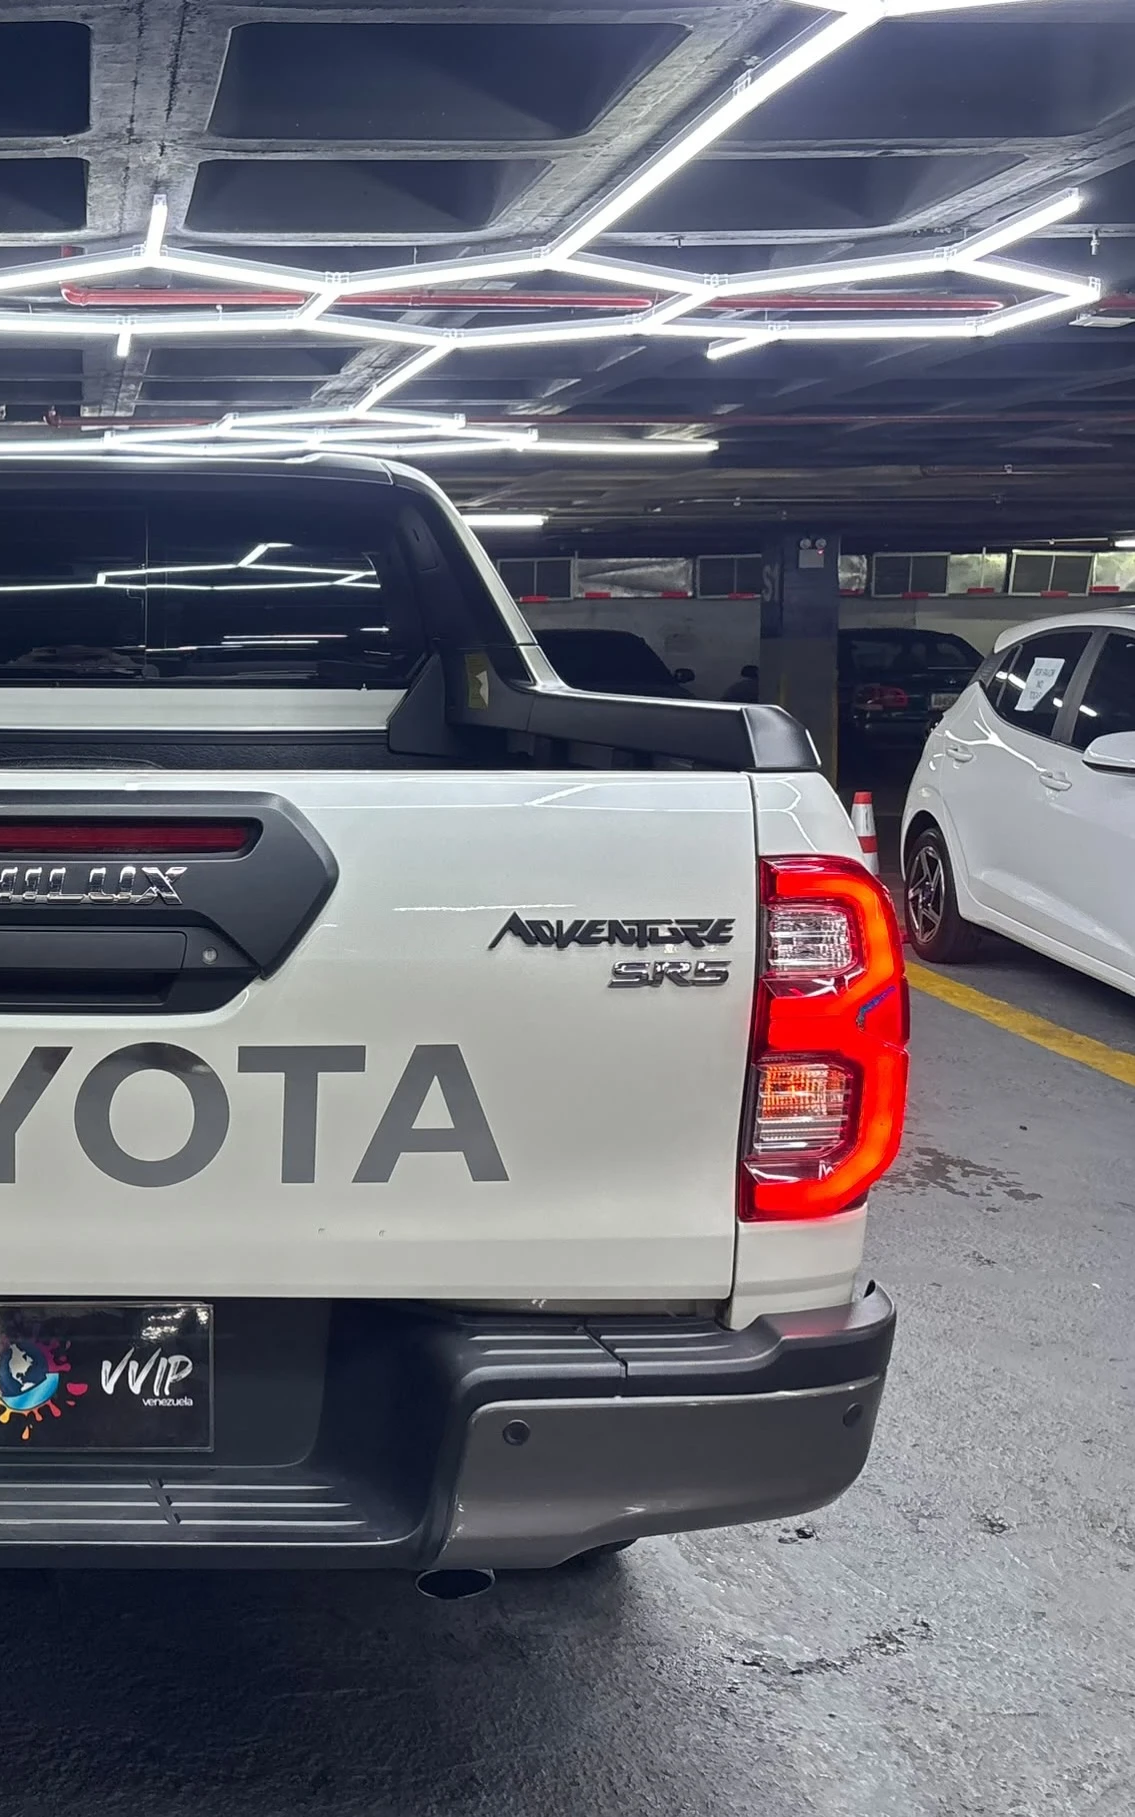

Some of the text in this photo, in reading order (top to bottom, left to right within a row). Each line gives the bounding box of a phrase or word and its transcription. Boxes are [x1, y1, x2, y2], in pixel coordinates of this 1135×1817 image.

[488, 911, 736, 949] ADVENTURE
[607, 960, 732, 988] SR5
[100, 1346, 194, 1397] VVIP
[142, 1396, 194, 1407] venezuela
